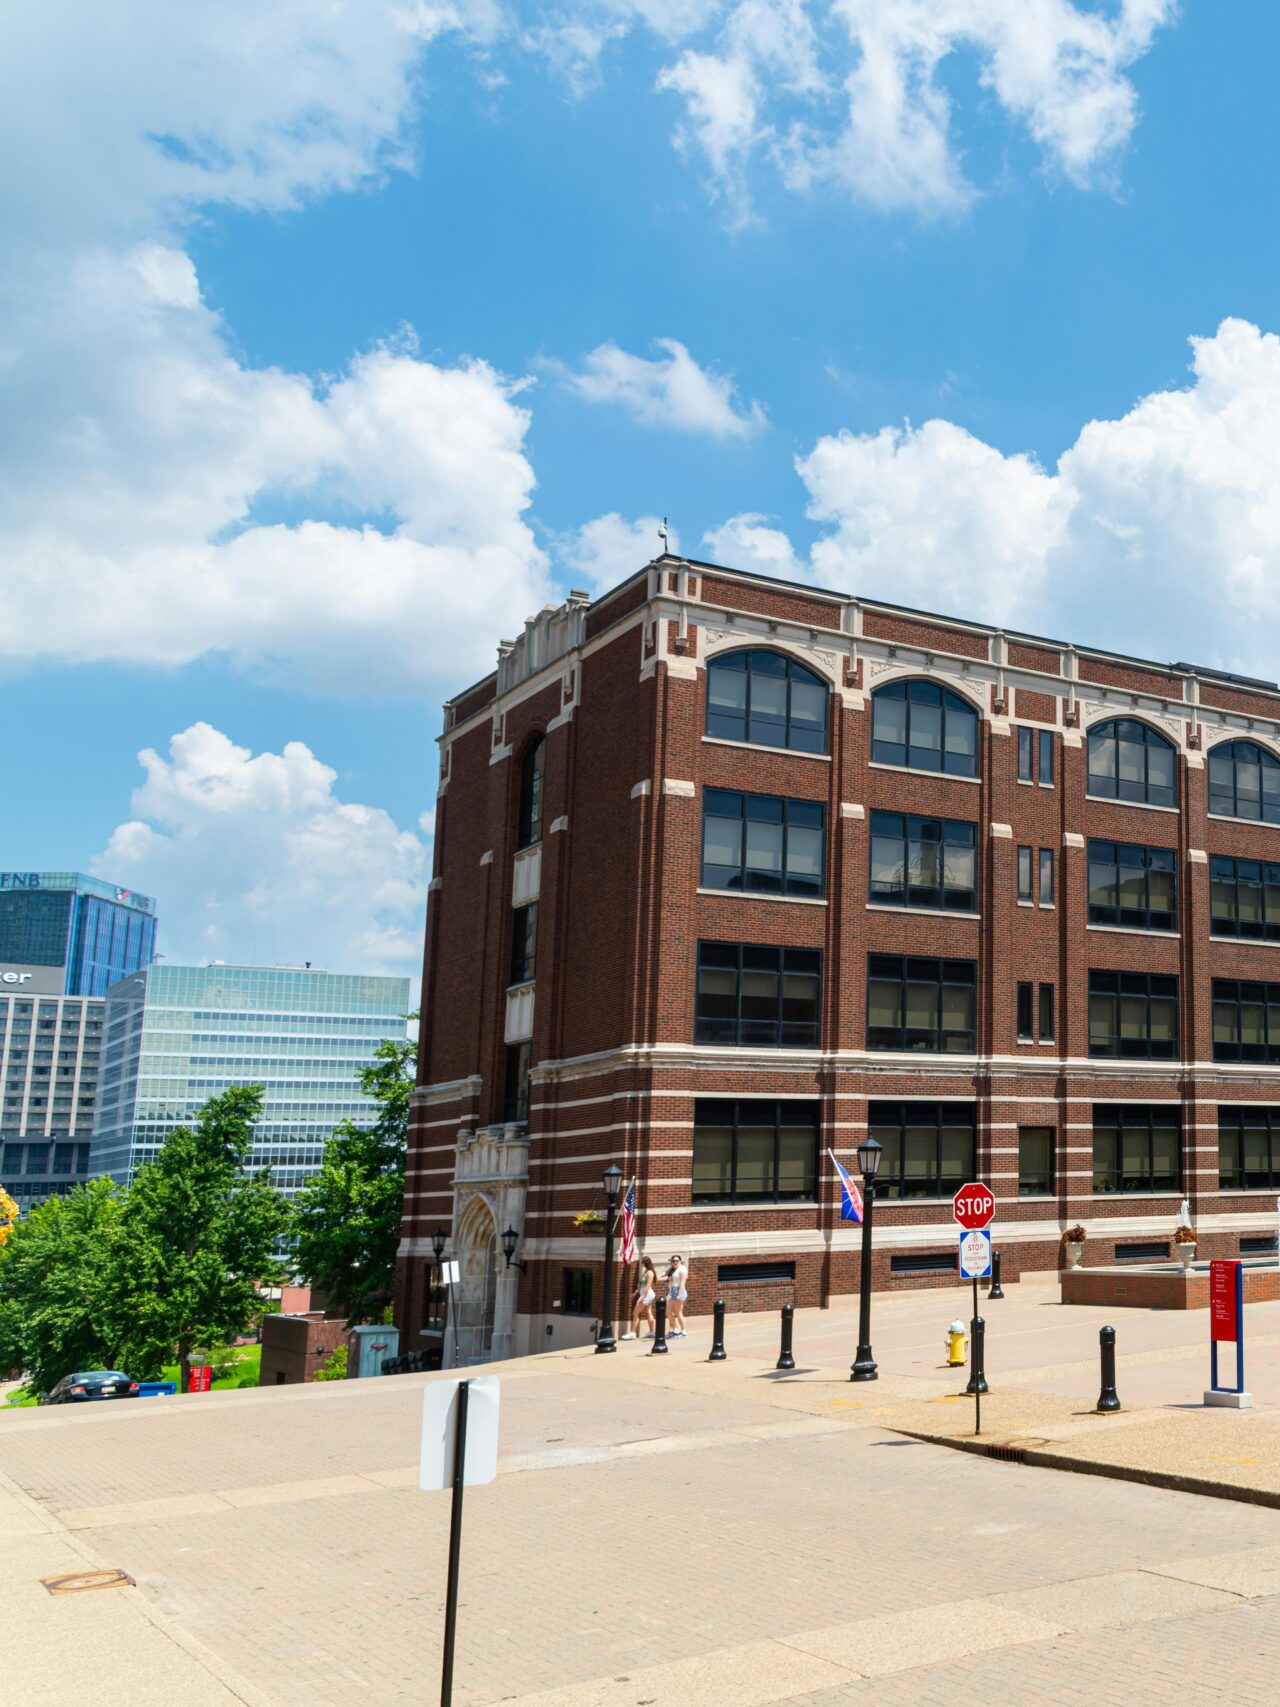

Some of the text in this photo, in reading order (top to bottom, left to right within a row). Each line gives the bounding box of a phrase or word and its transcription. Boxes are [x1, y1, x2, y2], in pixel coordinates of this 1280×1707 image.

[1, 873, 41, 887] FNB
[0, 971, 32, 984] er
[957, 1197, 992, 1216] STOP
[967, 1243, 984, 1252] STOP
